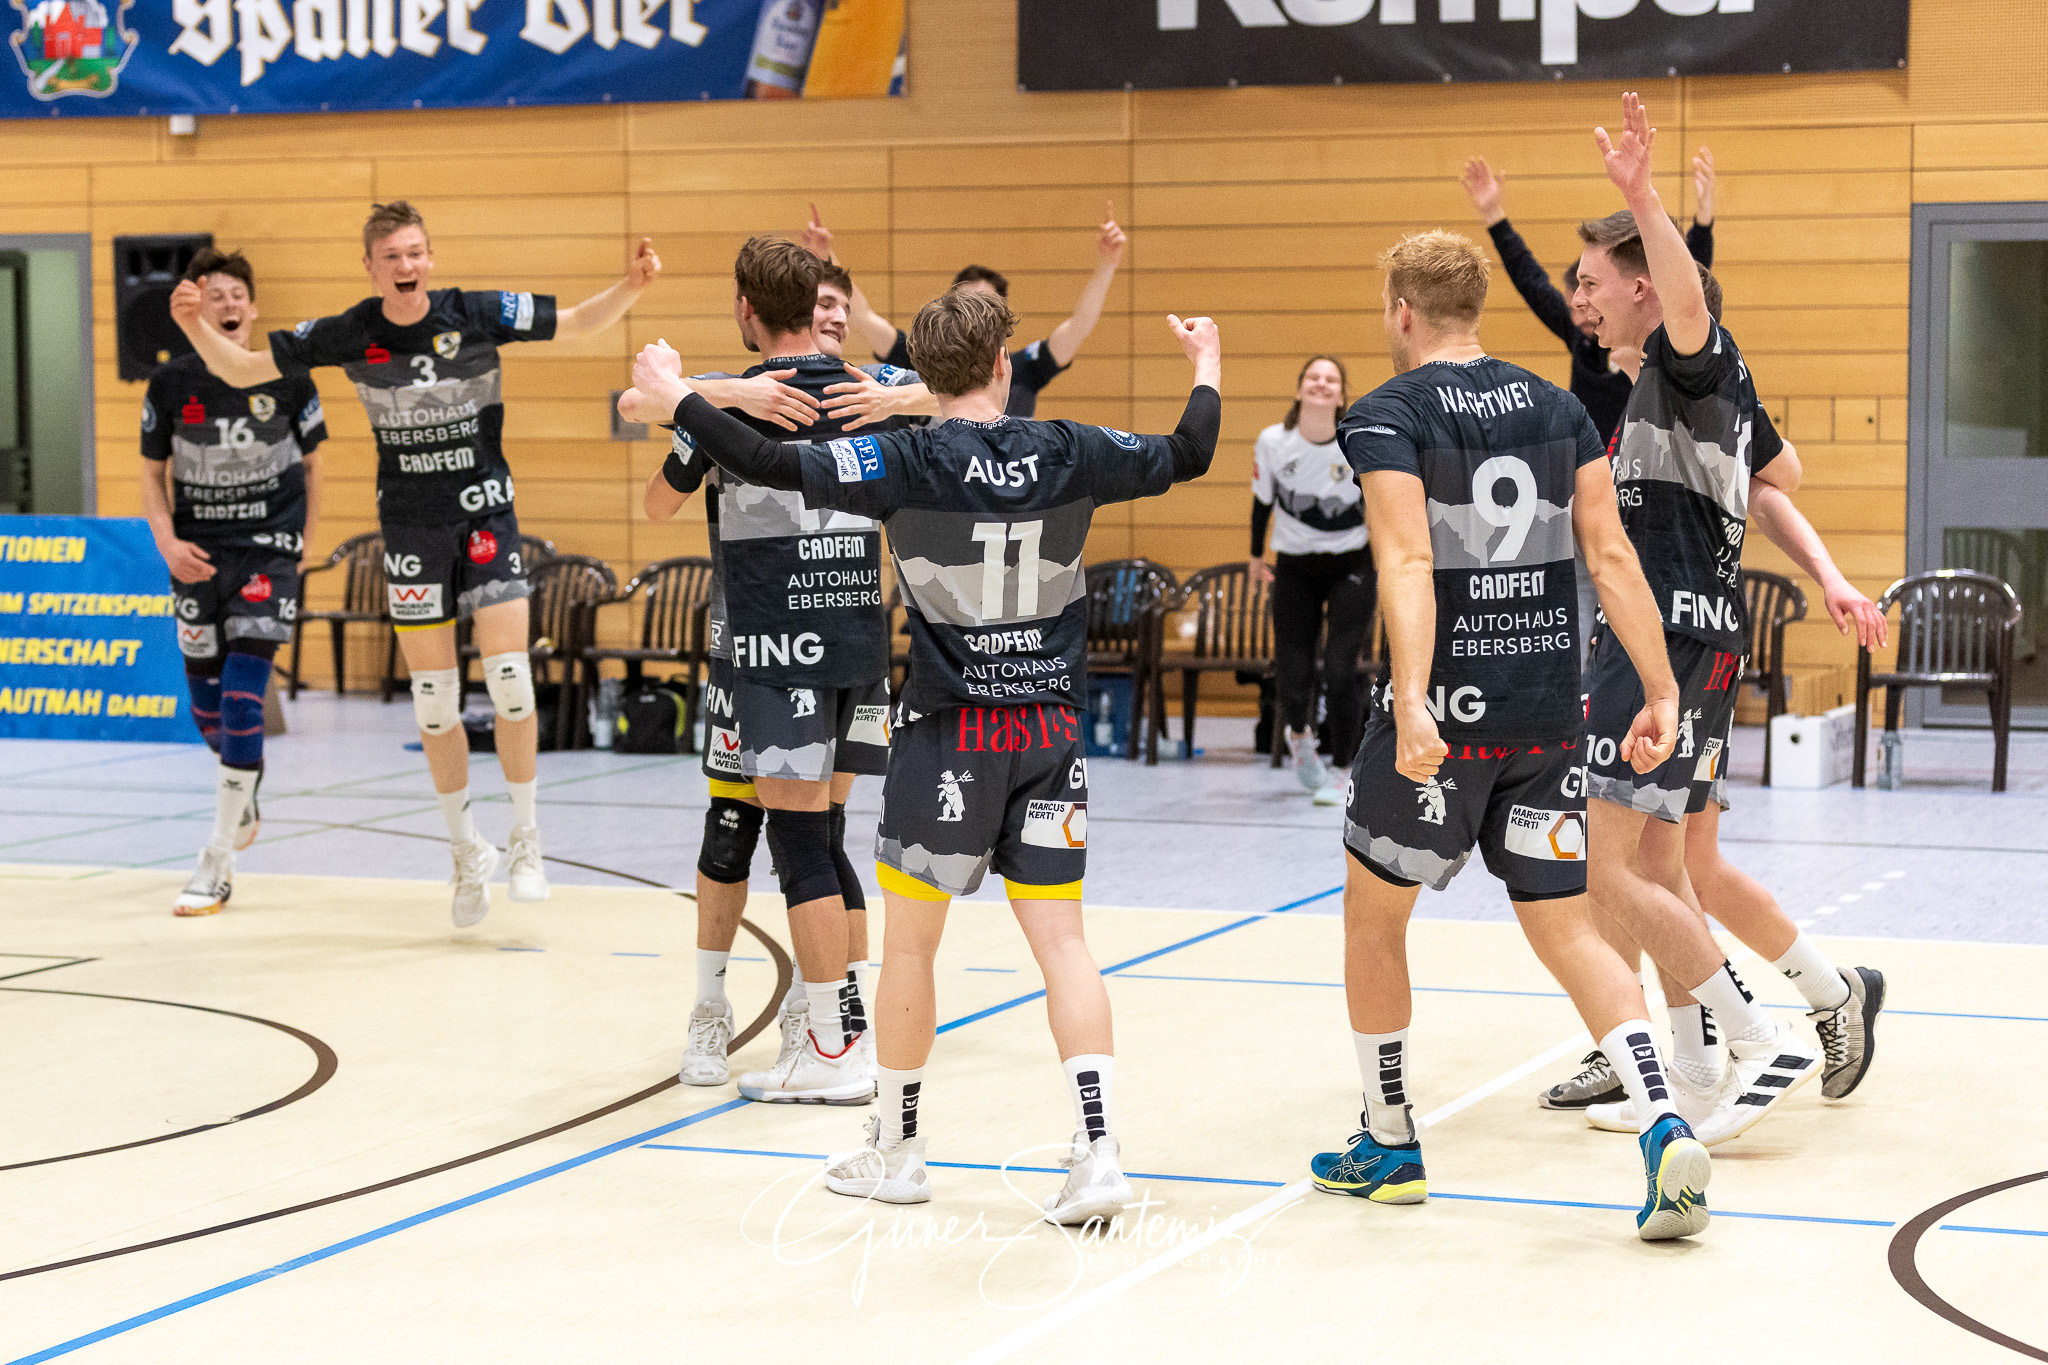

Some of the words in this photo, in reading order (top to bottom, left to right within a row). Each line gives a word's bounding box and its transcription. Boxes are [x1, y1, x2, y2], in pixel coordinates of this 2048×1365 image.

[410, 355, 438, 388] 3
[1436, 381, 1534, 419] NACHTWEY
[215, 418, 255, 450] 16
[380, 418, 479, 446] EBERSBERG
[399, 446, 475, 474] CADFEM
[963, 454, 1040, 487] AUST
[1472, 455, 1538, 562] 9
[798, 535, 866, 560] CADFEM
[508, 552, 522, 575] 3
[971, 519, 1043, 620] 11
[278, 597, 297, 621] 16
[788, 590, 880, 610] EBERSBERG
[1453, 607, 1568, 632] AUTOHAUS
[963, 628, 1043, 656] CADFEM
[1452, 632, 1571, 656] EBERSBERG
[962, 657, 1067, 680] AUTOHAUS
[966, 675, 1071, 698] EBERSBERG
[854, 714, 878, 723] KERTI
[856, 707, 885, 716] MARCUS
[1587, 734, 1617, 767] 10
[1027, 809, 1055, 821] KERTI
[1029, 802, 1065, 813] MARCUS
[1512, 807, 1550, 822] MARCUS
[1510, 816, 1540, 830] KERTI
